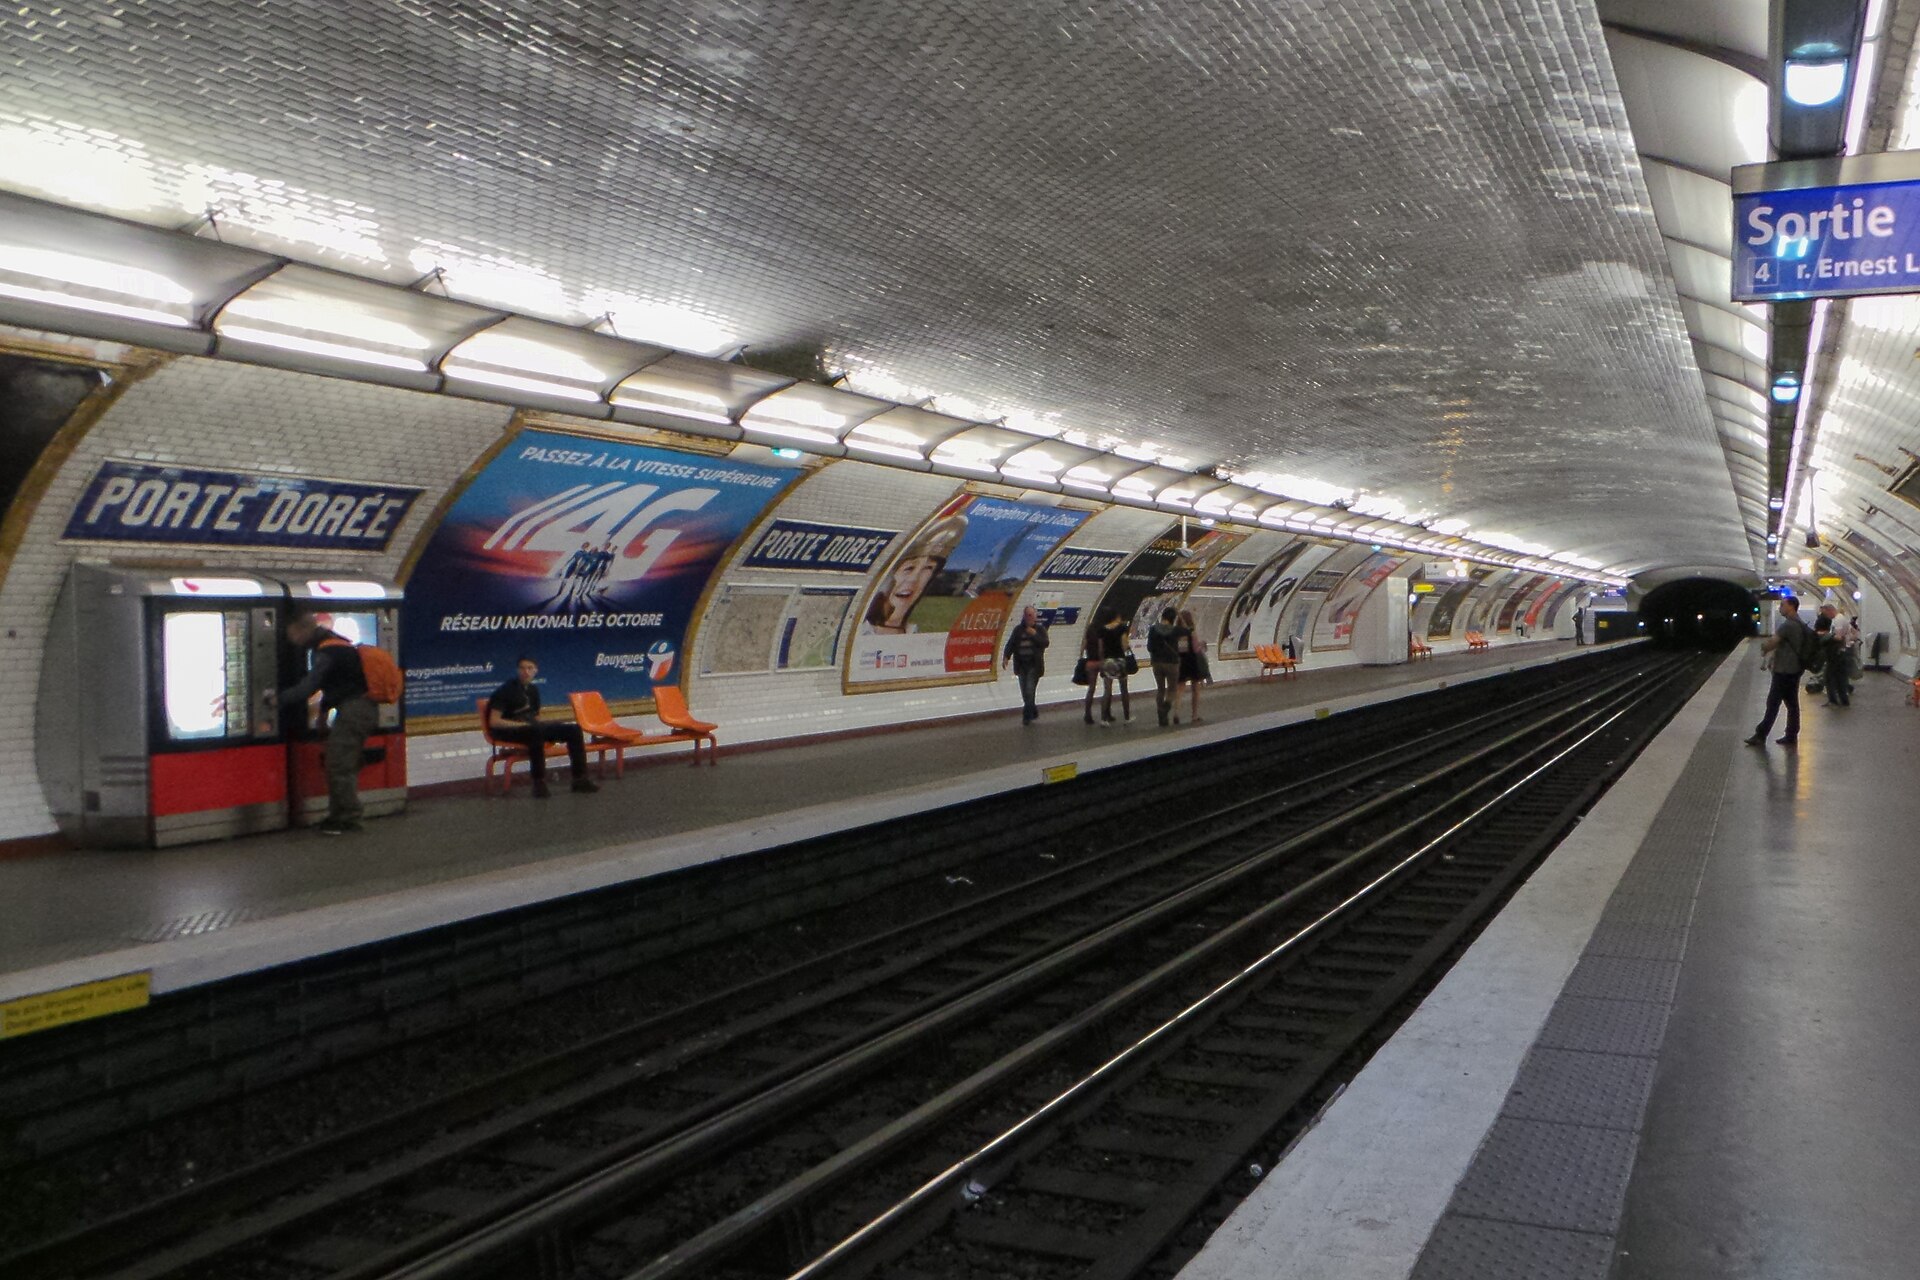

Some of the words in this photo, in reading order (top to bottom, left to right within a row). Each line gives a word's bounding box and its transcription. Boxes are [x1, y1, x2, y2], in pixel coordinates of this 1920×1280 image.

[1748, 198, 1896, 245] Sortie
[1755, 262, 1770, 282] 4
[1818, 255, 1898, 278] Ernest
[1905, 253, 1920, 273] L
[520, 446, 592, 467] PASSEZ
[589, 450, 607, 468] À
[606, 456, 631, 470] LA
[635, 460, 700, 479] VITESSE
[695, 467, 781, 488] SUPÉRIEURE
[84, 476, 258, 531] PORTE
[257, 488, 401, 539] DORÉE
[484, 481, 720, 581] 4G
[753, 529, 829, 561] PORTE
[818, 534, 888, 565] DORÉE
[441, 613, 502, 631] RÉSEAU
[504, 614, 574, 629] NATIONAL
[578, 611, 604, 628] DÈS
[606, 613, 663, 627] OCTOBRE
[405, 663, 493, 679] ouyguestelecom.fr
[596, 652, 645, 668] Bouygues
